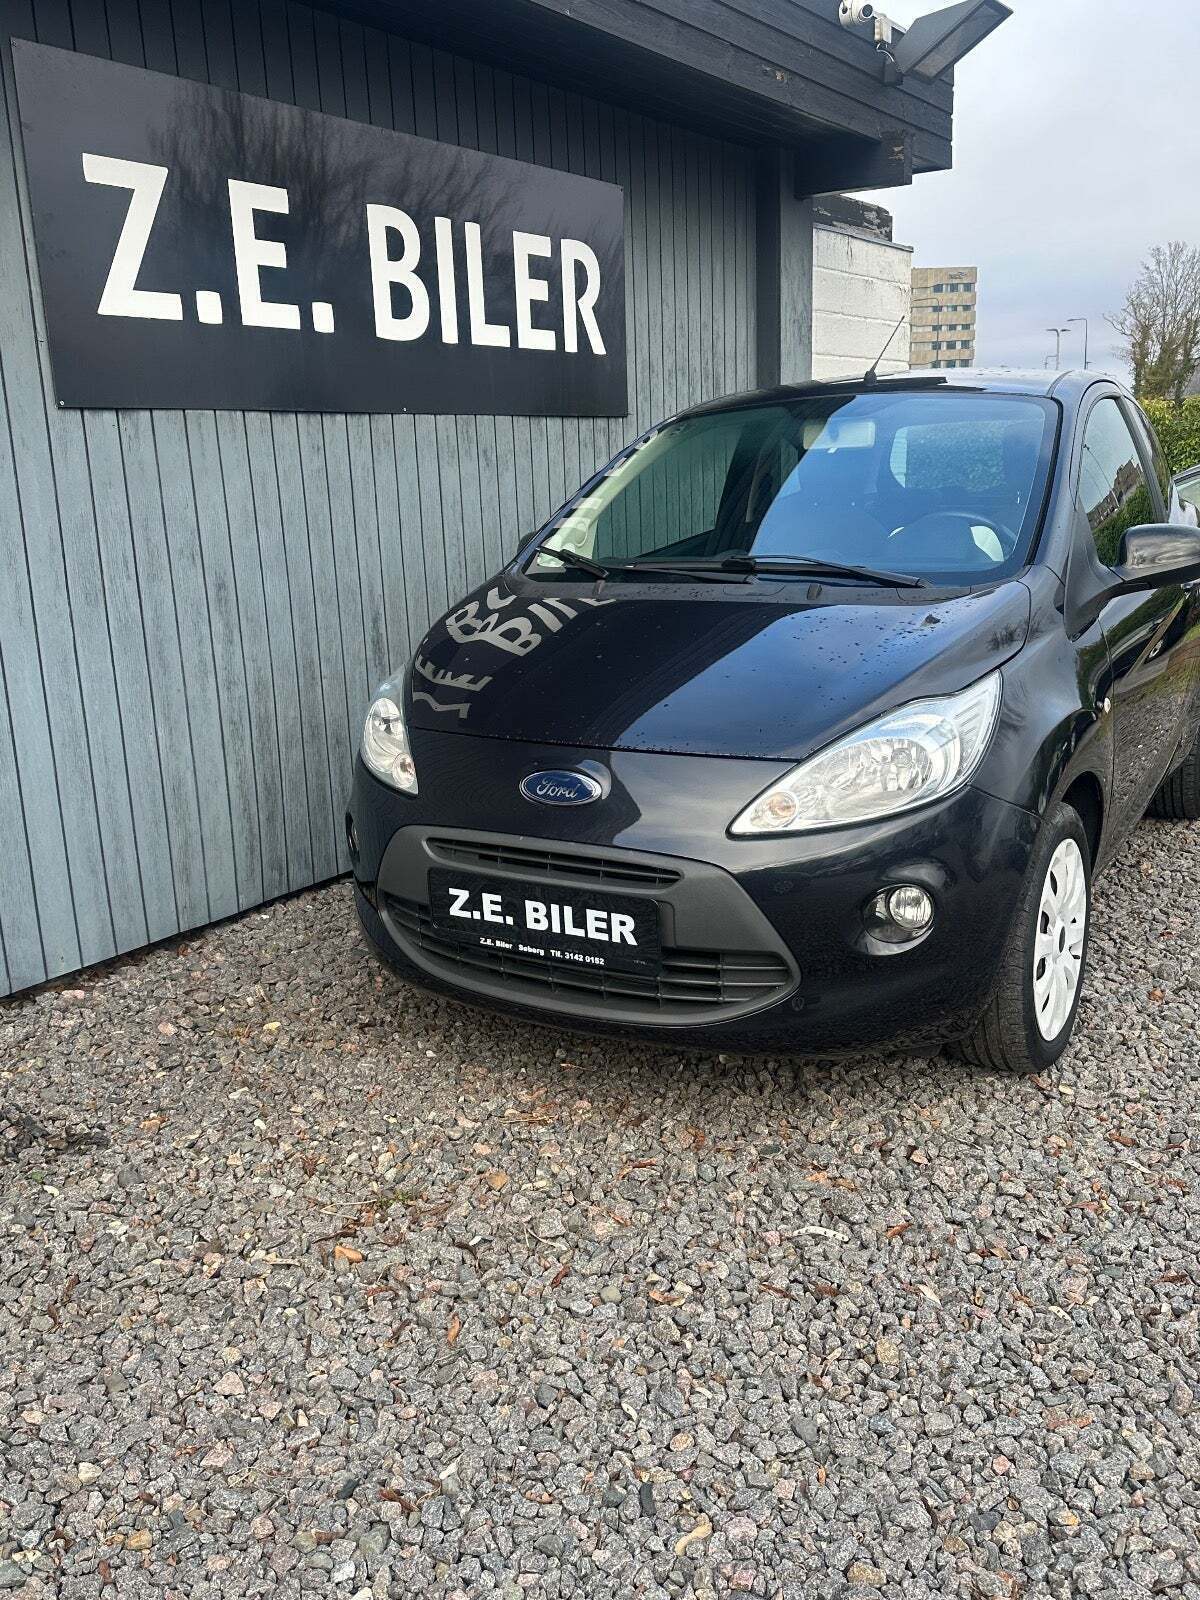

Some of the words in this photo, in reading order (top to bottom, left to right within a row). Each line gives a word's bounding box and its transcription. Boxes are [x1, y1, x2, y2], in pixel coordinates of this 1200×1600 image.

[82, 152, 335, 334] Z.E.
[366, 203, 607, 356] BILER
[536, 777, 581, 798] Ford
[448, 887, 514, 926] Z.E.
[524, 899, 638, 946] BILER
[479, 937, 495, 946] Z.E.
[495, 940, 513, 950] Biler
[564, 951, 584, 962] 3142
